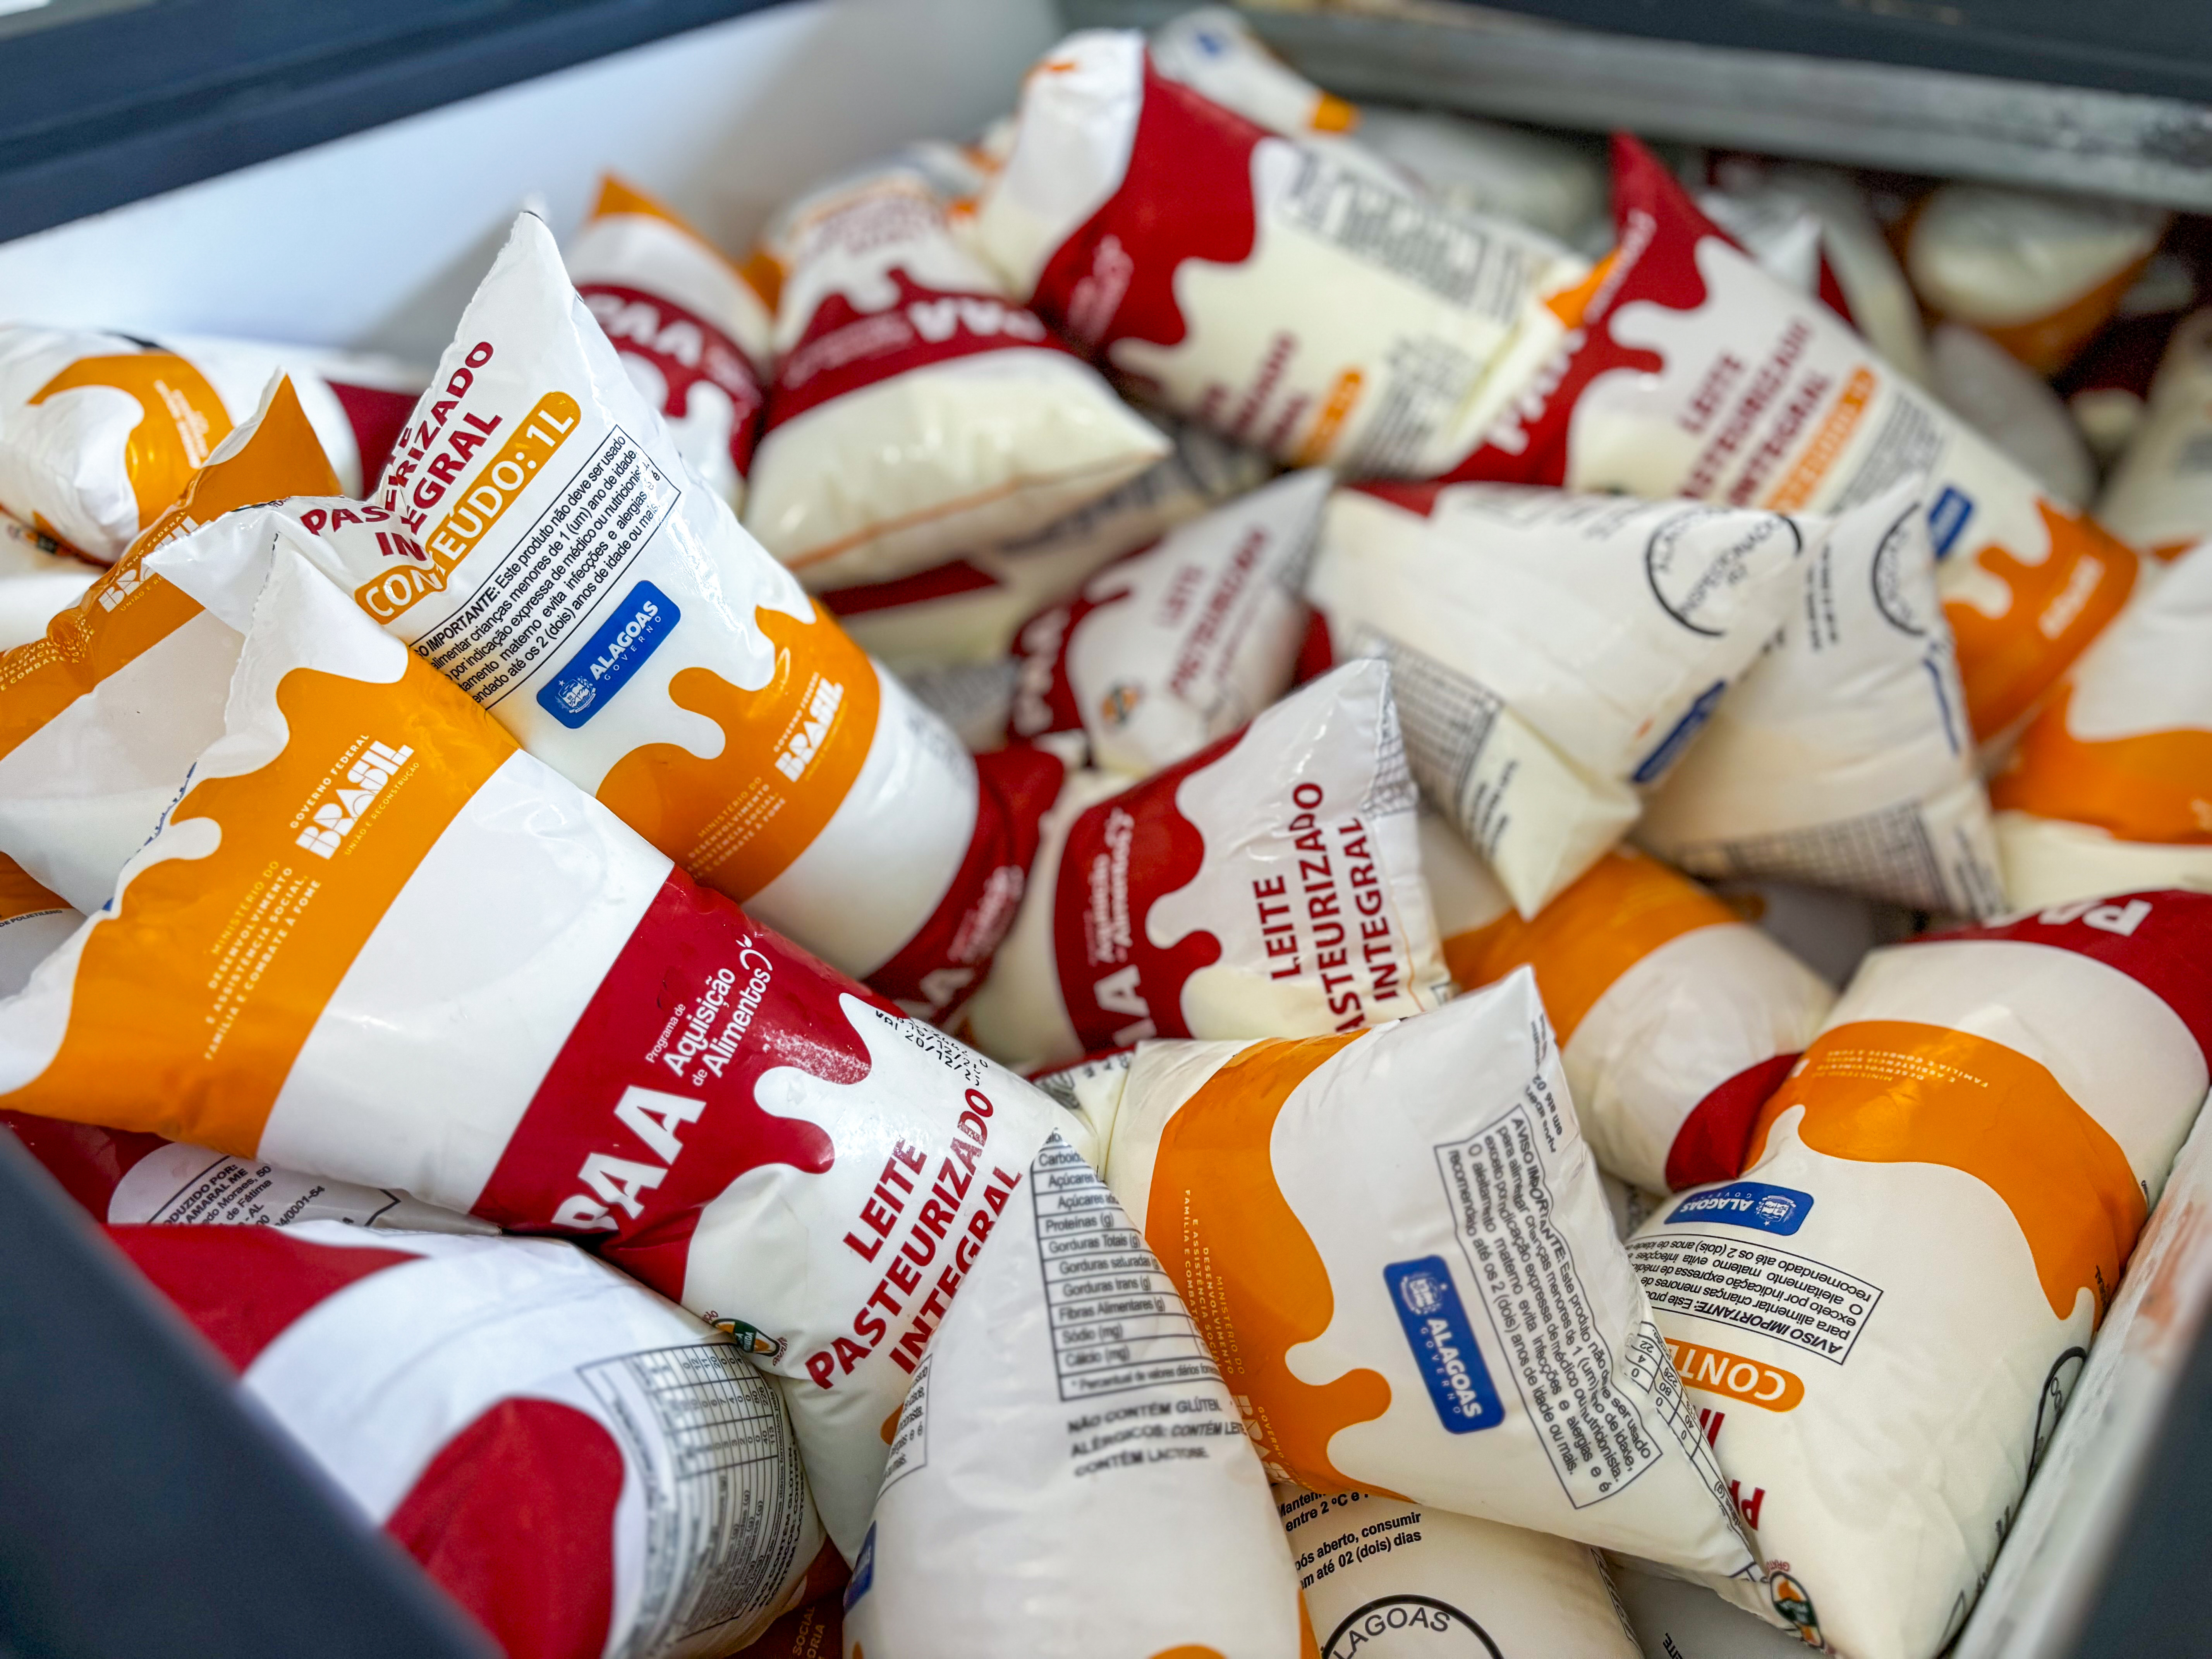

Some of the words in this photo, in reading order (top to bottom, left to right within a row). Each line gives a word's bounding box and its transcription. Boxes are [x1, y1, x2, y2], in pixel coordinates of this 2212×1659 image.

[522, 400, 575, 453] 1L
[587, 487, 607, 511] ano
[600, 472, 618, 491] de
[426, 584, 501, 652] IMPORTANTE:
[495, 559, 522, 589] Este
[517, 522, 555, 567] produto
[551, 503, 572, 527] não
[565, 478, 592, 507] deve
[588, 462, 605, 482] ser
[601, 434, 627, 466] usado
[557, 530, 570, 543] 1
[563, 505, 594, 536] (um)
[498, 616, 543, 662] materno
[539, 589, 568, 618] evita
[563, 539, 610, 591] infecções
[607, 529, 618, 541] e
[615, 490, 648, 530] alergias
[649, 469, 661, 481] é
[545, 538, 565, 558] de
[450, 661, 470, 680] por
[464, 623, 514, 666] indicação
[510, 578, 555, 628] expressa
[548, 562, 567, 582] de
[562, 527, 597, 567] médico
[592, 514, 609, 531] ou
[508, 553, 551, 602] menores
[469, 599, 513, 642] crianças
[505, 656, 527, 678] até
[523, 644, 541, 662] os
[535, 634, 549, 649] 2
[542, 605, 578, 642] (dois)
[572, 580, 597, 610] anos
[591, 566, 610, 585] de
[603, 538, 632, 570] idade
[627, 526, 643, 542] ou
[430, 636, 473, 670] alimentar
[587, 599, 659, 680] ALAGOAS
[603, 615, 662, 681] GOVERNO
[773, 677, 843, 783] BRASIL
[289, 776, 332, 830] GOVERNO
[330, 734, 369, 776] FEDERAL
[294, 740, 415, 860] BRASIL
[344, 827, 367, 856] UNIÃO
[371, 761, 420, 820] RECONSTRUÇÃO
[207, 866, 293, 990] DESENVOLVIMENTO
[210, 879, 266, 956] MINISTÉRIO
[263, 859, 280, 879] DO
[1252, 874, 1303, 981] LEITE
[1289, 781, 1366, 1033] ASTEURIZADO
[1339, 817, 1399, 1003] INTEGRAL
[243, 928, 288, 991] COMBATE
[292, 878, 321, 915] FOME
[644, 1014, 680, 1064] Programa
[671, 1001, 687, 1017] de
[663, 966, 738, 1078] Aquisição
[702, 967, 773, 1078] Alimentos
[550, 1083, 708, 1230] PAA
[1483, 1134, 1506, 1180] exceto
[1511, 1116, 1535, 1164] AVISO
[186, 1181, 230, 1224] AMARAL
[228, 1167, 248, 1185] ME
[210, 1161, 238, 1186] POR:
[218, 1173, 258, 1209] Moraes,
[255, 1163, 272, 1179] 50
[238, 1178, 272, 1209] Fátima
[1048, 1169, 1095, 1190] Açúcares
[247, 1200, 264, 1217] AL
[844, 1137, 931, 1264] LEITE
[1045, 1213, 1097, 1233] Proteínas
[1680, 1198, 1753, 1212] ALAGOAS
[805, 1087, 993, 1392] PASTEURIZADO
[1048, 1237, 1100, 1254] Gorduras
[1726, 1246, 1738, 1260] 2
[890, 1165, 1023, 1375] INTEGRAL
[1059, 1254, 1109, 1274] Gorduras
[1192, 1231, 1209, 1318] ASSISTÊNCIA
[1559, 1261, 1577, 1294] Este
[1674, 1267, 1725, 1283] expressa
[1712, 1258, 1762, 1278] materno
[1777, 1259, 1872, 1302] recomendado
[1063, 1278, 1114, 1297] Gorduras
[1202, 1247, 1233, 1374] DESENVOLVIMENTO
[1666, 1295, 1693, 1309] Este
[1702, 1286, 1753, 1306] crianças
[1724, 1277, 1784, 1302] indicação
[1765, 1271, 1844, 1306] aleitamento
[1784, 1291, 1809, 1308] por
[1847, 1302, 1864, 1316] O
[1216, 1276, 1238, 1352] MINISTÉRIO
[1233, 1358, 1245, 1375] DO
[1566, 1294, 1592, 1343] produto
[1693, 1300, 1790, 1334] IMPORTANTE:
[1752, 1298, 1815, 1328] alimentar
[1809, 1301, 1856, 1328] exceto
[1815, 1320, 1850, 1341] para
[1491, 1236, 1528, 1296] materno
[1531, 1334, 1563, 1396] infecções
[1565, 1415, 1595, 1462] alergias
[1789, 1327, 1843, 1353] AVISO
[1420, 1326, 1461, 1413] GOVERNO
[1427, 1315, 1482, 1418] ALAGOAS
[1556, 1441, 1581, 1475] mais.
[1613, 1429, 1639, 1472] idade,
[1284, 1508, 1319, 1531] entre
[1317, 1499, 1330, 1514] 2
[1350, 1491, 1360, 1502] e
[1313, 1558, 1337, 1580] até
[1336, 1550, 1355, 1568] 02
[1353, 1535, 1393, 1563] (dois)
[1391, 1526, 1422, 1548] dias
[1315, 1533, 1359, 1558] aberto,
[1360, 1512, 1422, 1539] consumir
